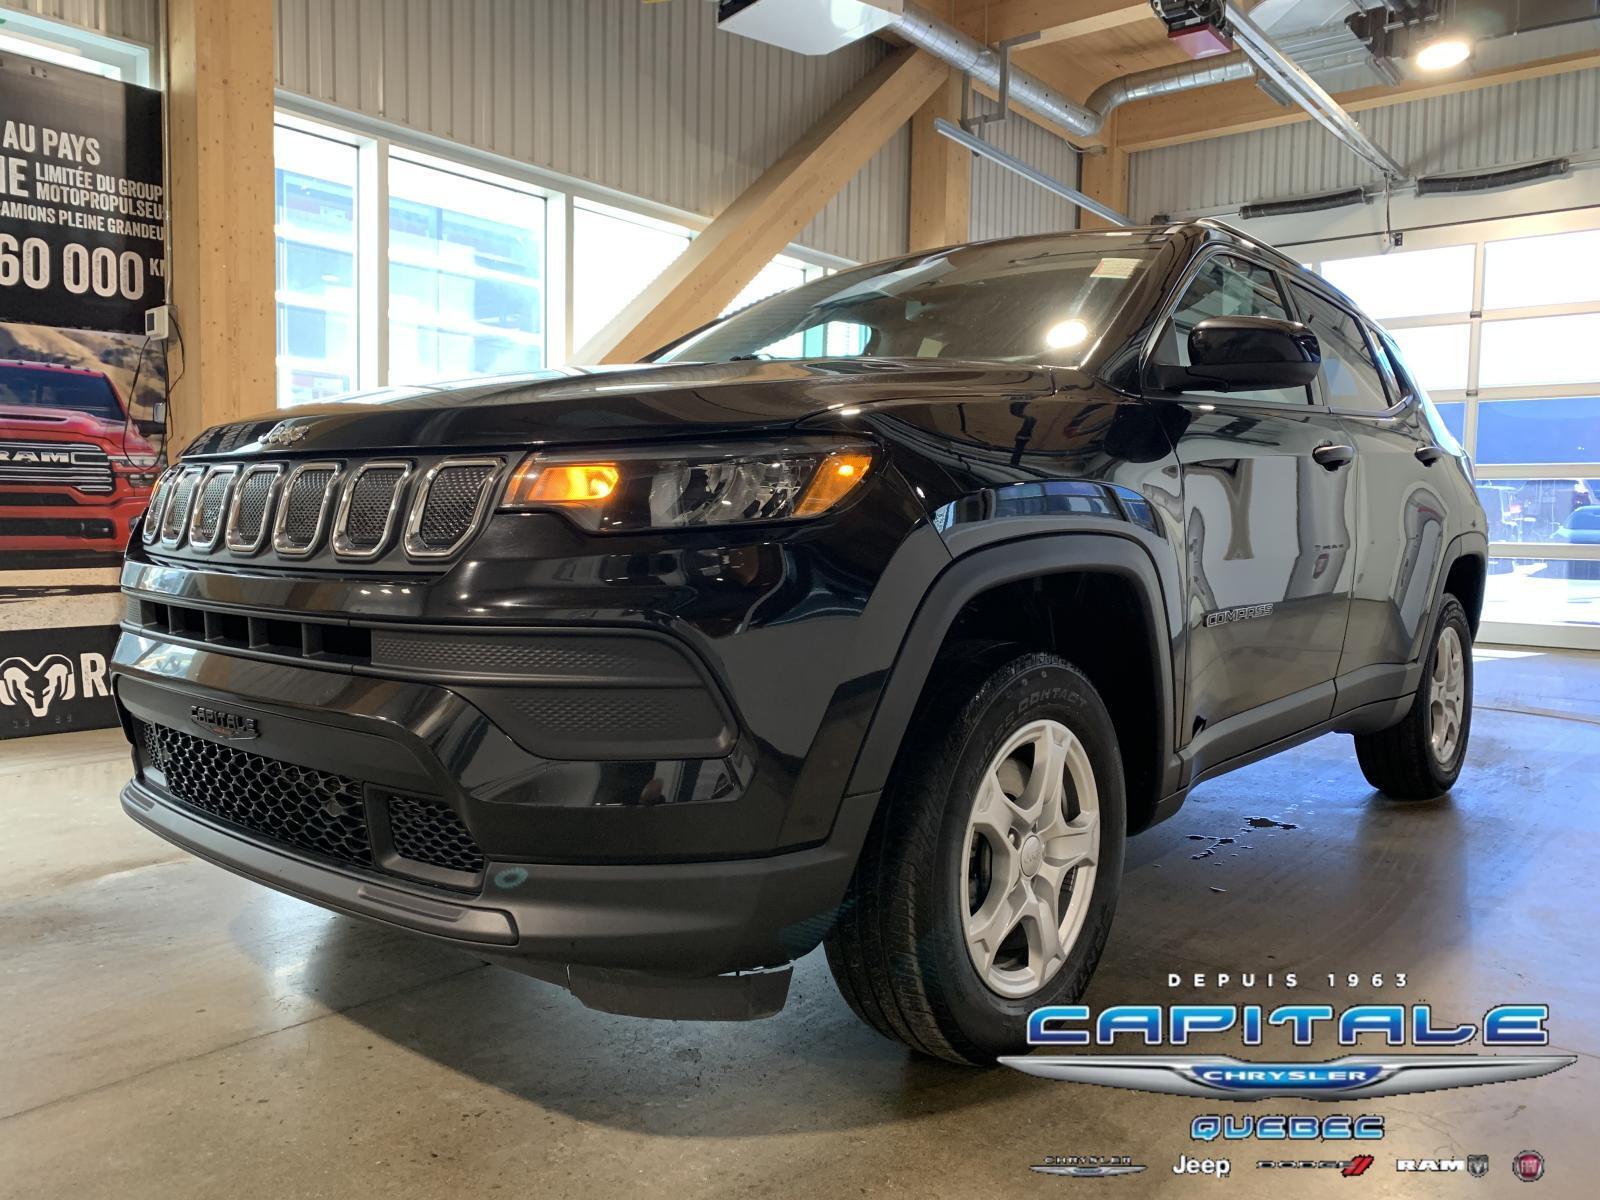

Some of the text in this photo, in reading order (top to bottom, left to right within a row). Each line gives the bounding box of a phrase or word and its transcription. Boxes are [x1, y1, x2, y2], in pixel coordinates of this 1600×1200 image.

[3, 120, 101, 166] AU PAYS
[35, 161, 93, 190] LIMITÉE
[96, 173, 115, 193] DU
[118, 178, 164, 201] GROUP
[36, 181, 165, 221] MOTOPROPULSEU
[0, 200, 164, 241] AMIONS PLEINE GRANDEU
[63, 242, 144, 301] 000
[1206, 603, 1274, 628] COMPASS
